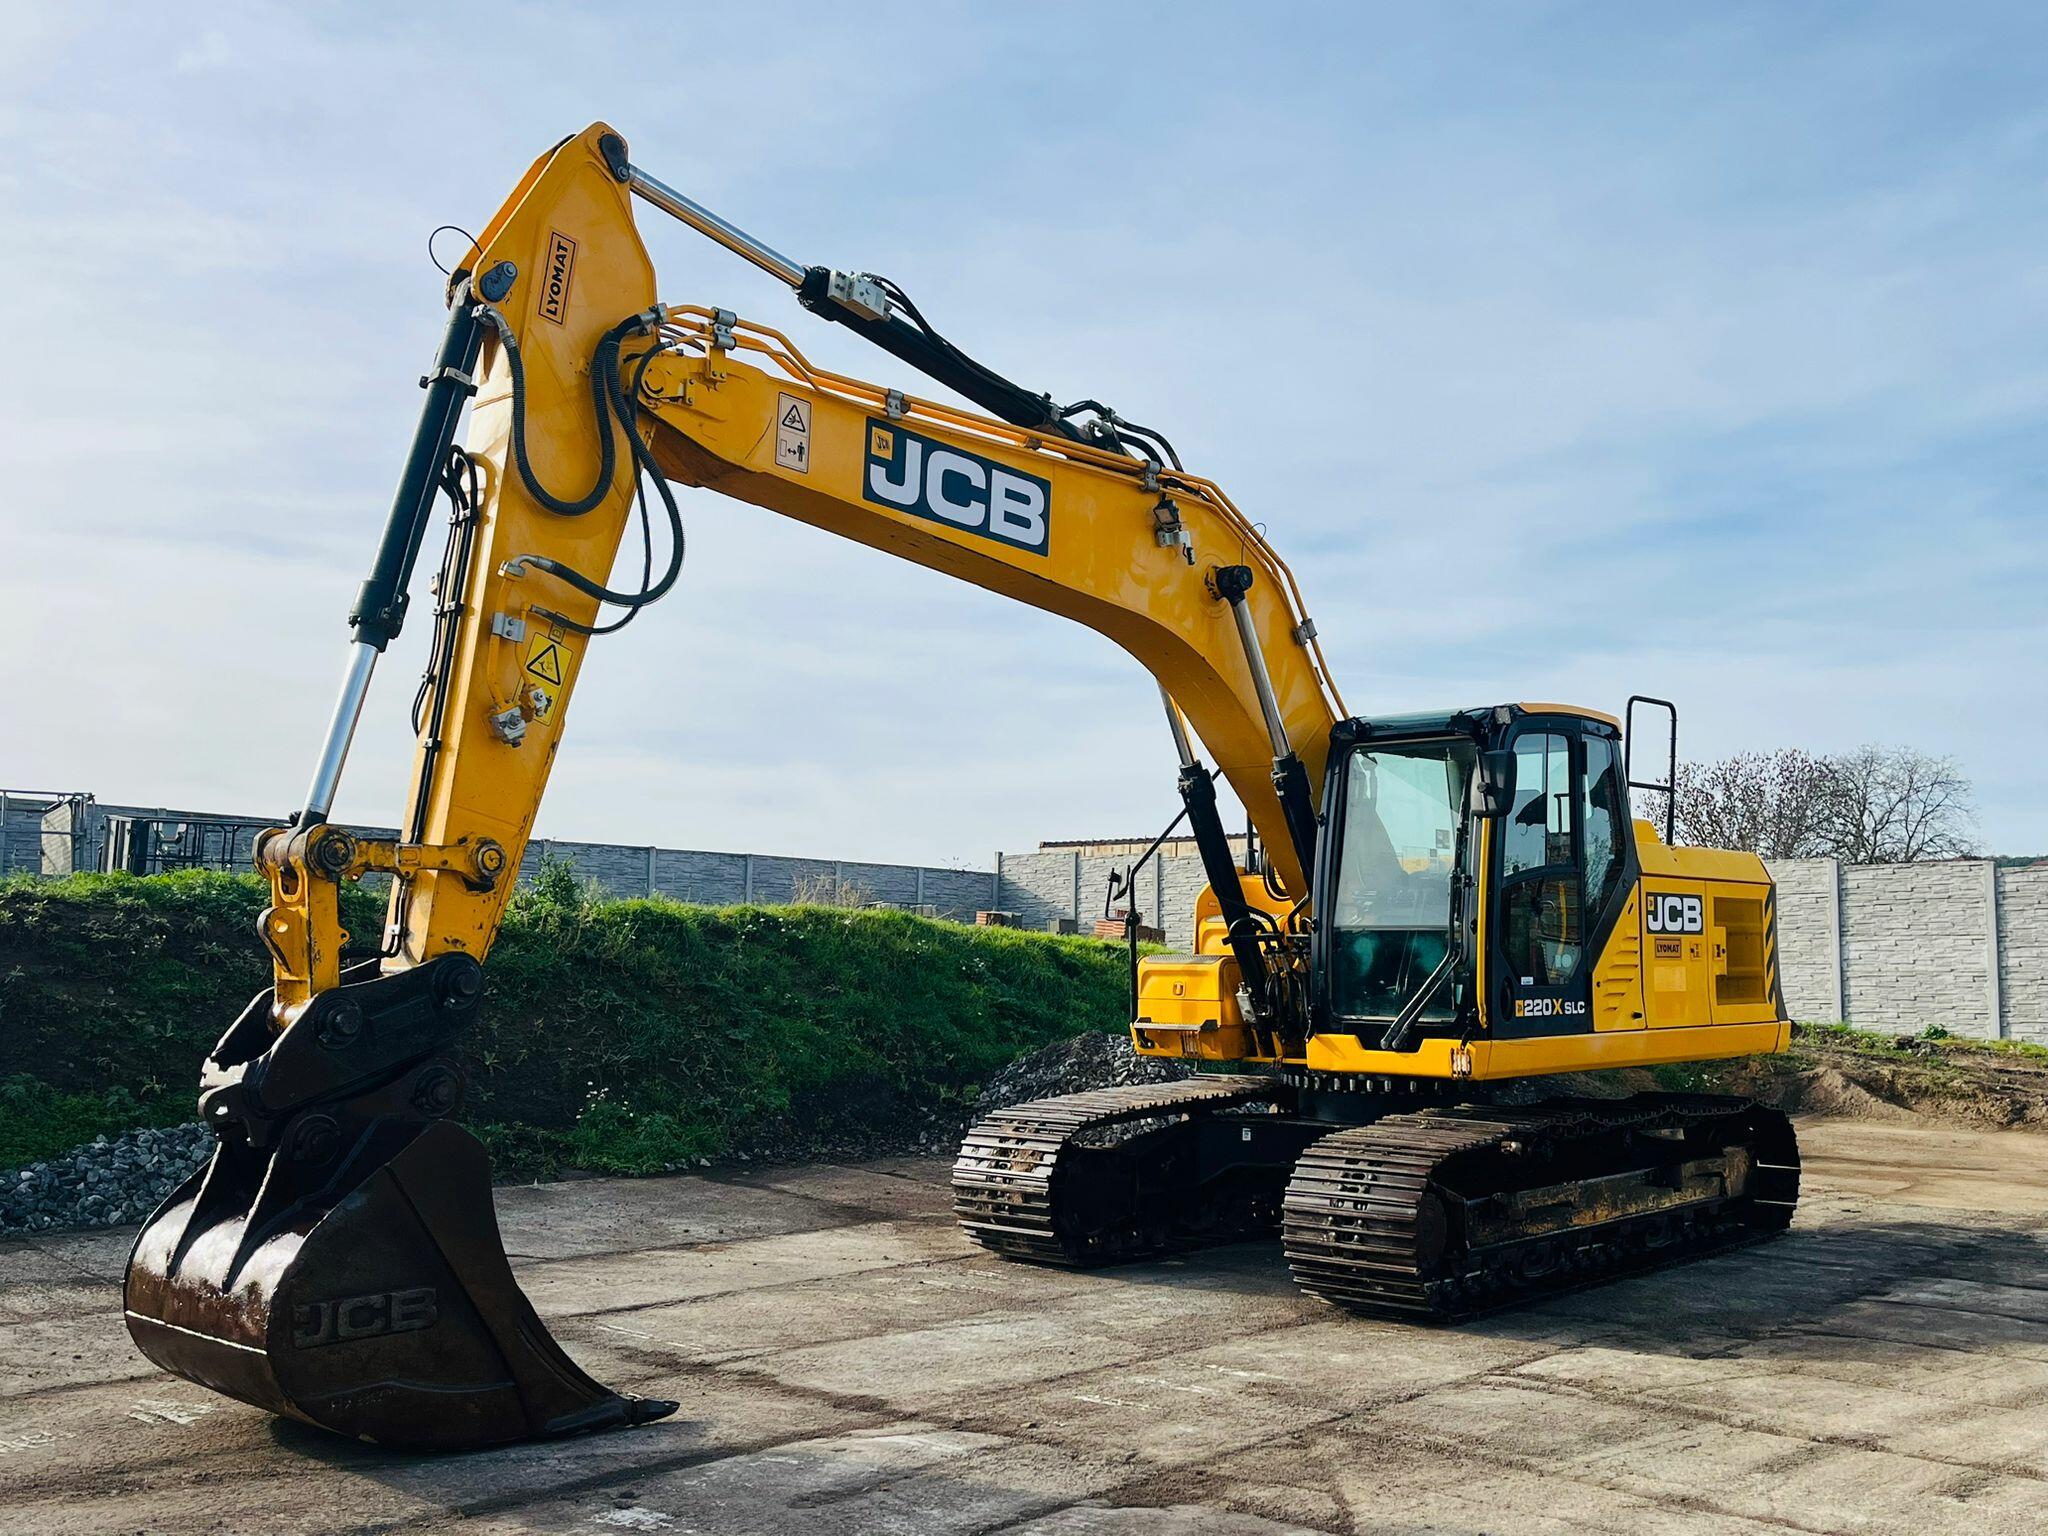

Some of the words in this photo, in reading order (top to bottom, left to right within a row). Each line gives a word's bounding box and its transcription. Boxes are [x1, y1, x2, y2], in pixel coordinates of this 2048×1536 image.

[546, 241, 568, 316] LYOMAT
[870, 438, 1045, 546] JCB
[1647, 896, 1702, 931] JCB
[1656, 944, 1680, 953] LYOMAT
[1564, 1001, 1585, 1015] SLC
[294, 1288, 437, 1348] JCB
